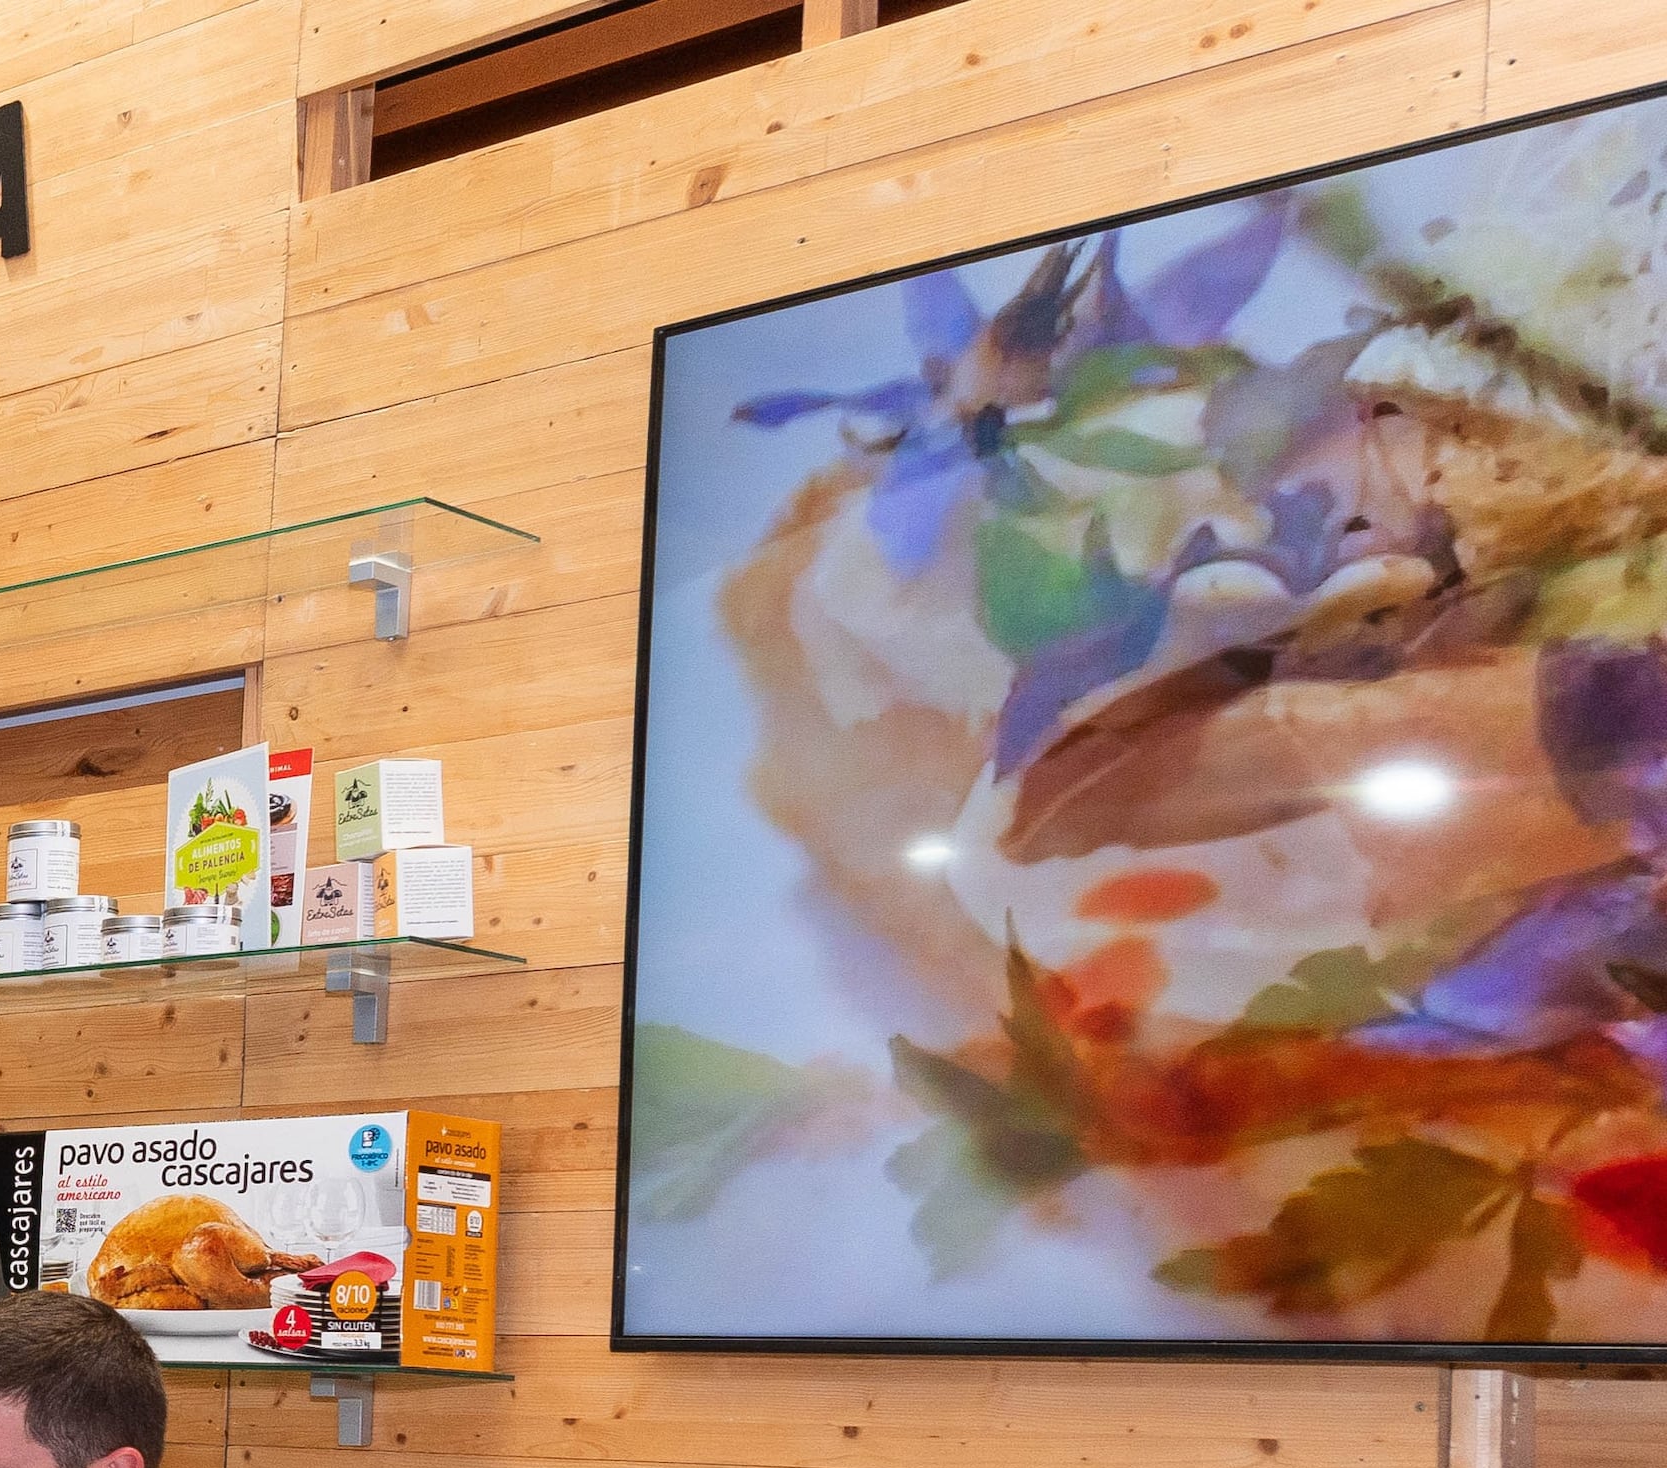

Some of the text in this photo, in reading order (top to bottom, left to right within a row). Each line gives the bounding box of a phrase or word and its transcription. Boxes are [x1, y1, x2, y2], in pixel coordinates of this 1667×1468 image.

[191, 838, 242, 859] ALIMENTOS
[188, 851, 246, 874] DE PALENCIA
[59, 1130, 217, 1175] pavo asado
[425, 1139, 487, 1160] pavo asado
[57, 1174, 108, 1190] al estilo
[161, 1153, 314, 1194] cascajares
[56, 1190, 121, 1202] americano
[8, 1145, 39, 1291] cascajares
[335, 1284, 371, 1305] 8/10
[285, 1309, 296, 1327] 4
[336, 1306, 369, 1315] raciones
[277, 1328, 308, 1338] salsas
[327, 1321, 376, 1332] SIN GLUTEN
